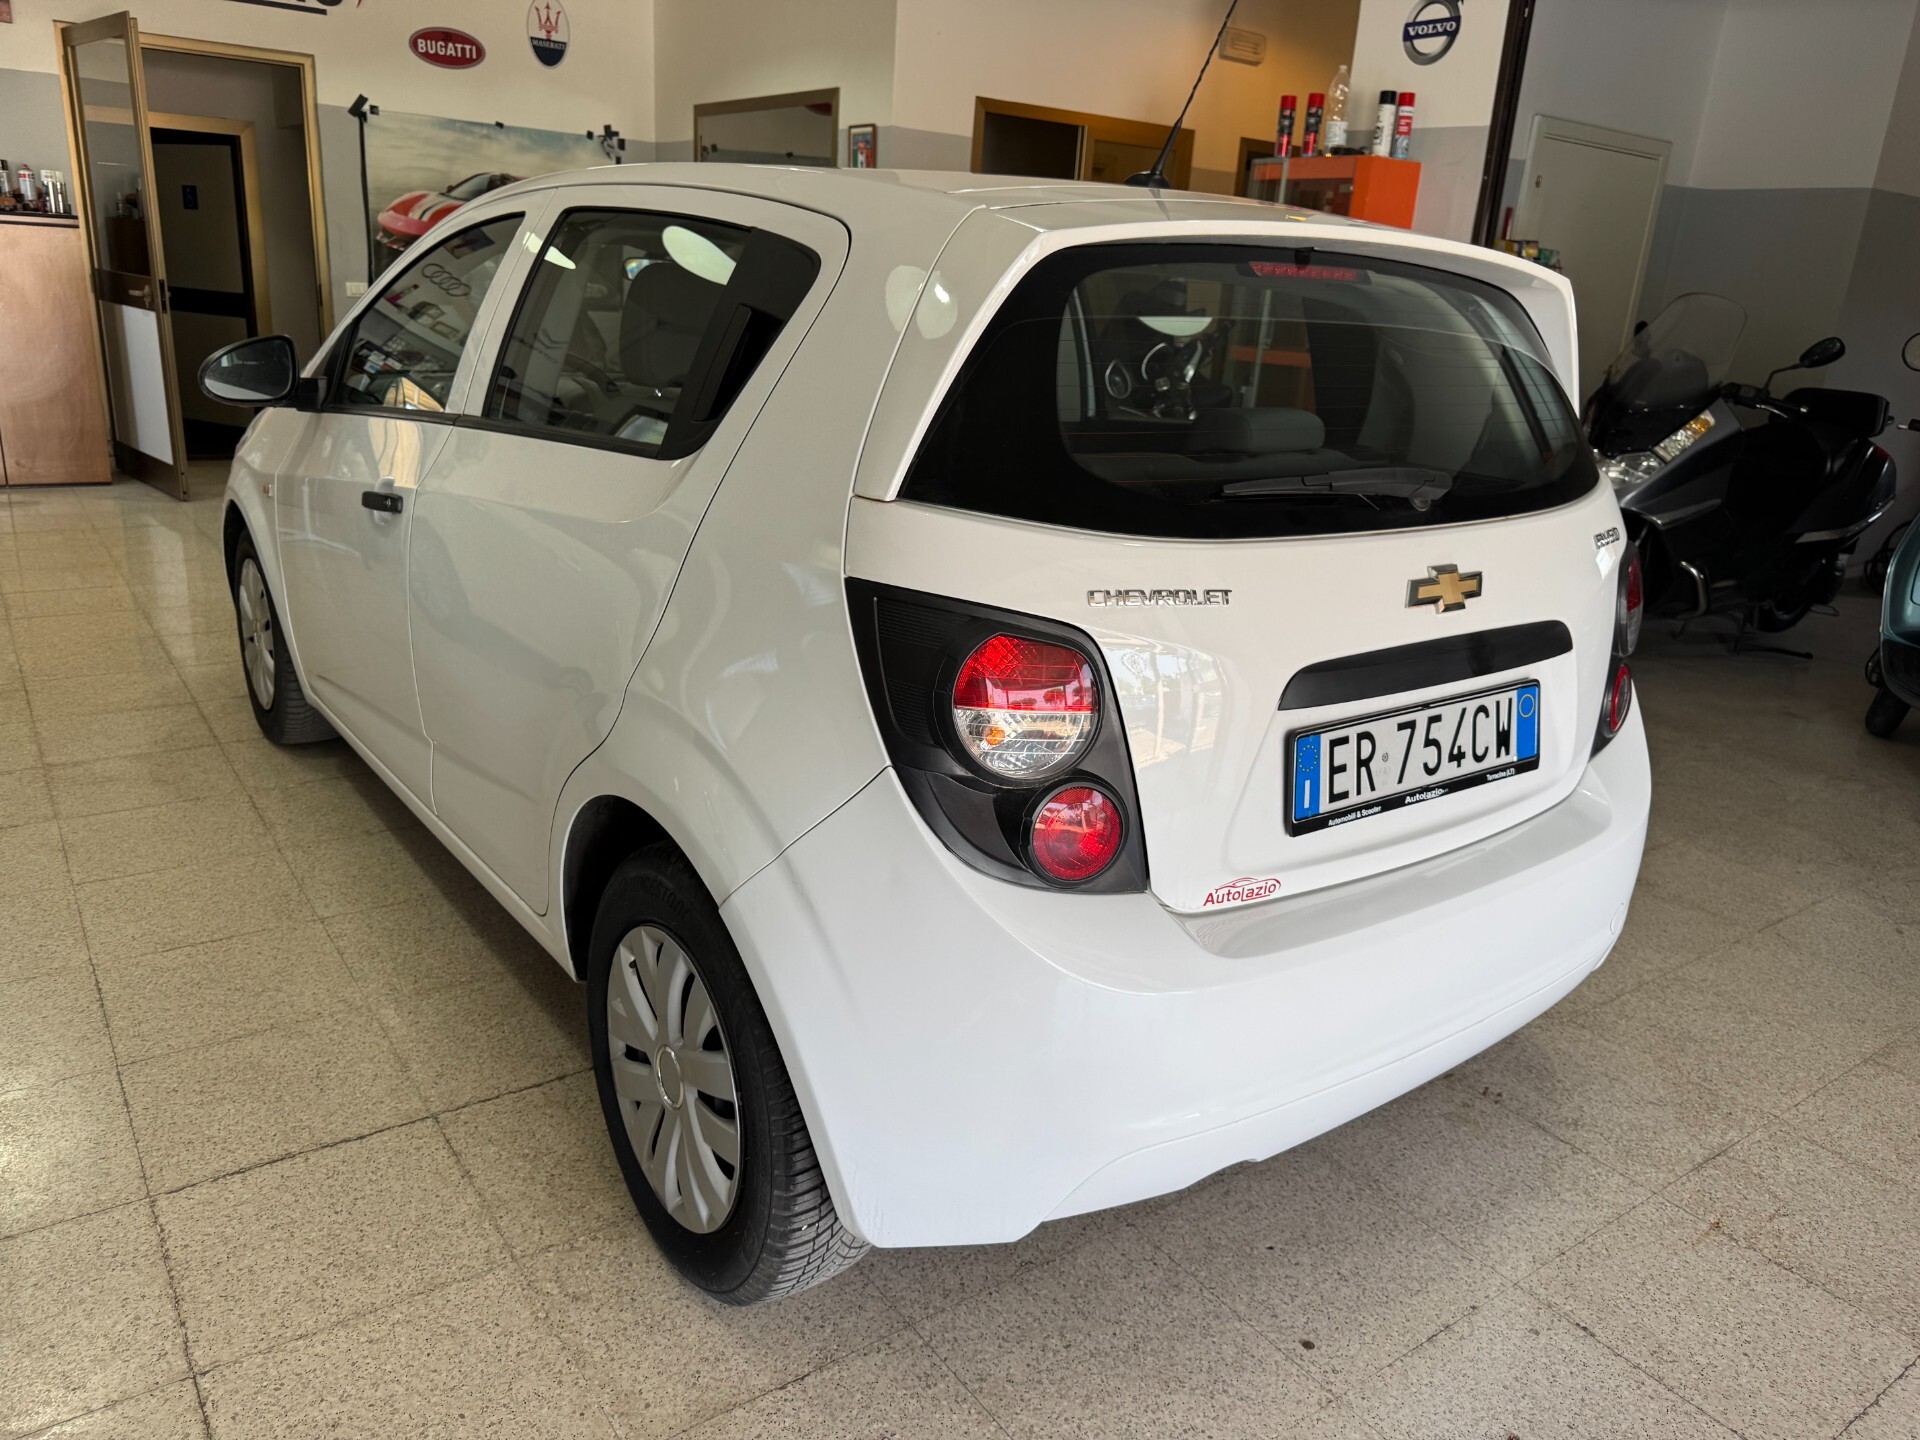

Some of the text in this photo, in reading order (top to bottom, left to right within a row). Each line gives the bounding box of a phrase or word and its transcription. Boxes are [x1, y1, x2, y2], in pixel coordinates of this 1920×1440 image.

[1407, 21, 1456, 37] VOLVO
[417, 39, 477, 59] BUGATTI
[1087, 589, 1232, 607] CHEVROLET
[1328, 697, 1513, 804] ER 754CW
[1328, 806, 1382, 826] Automobili & Scooter
